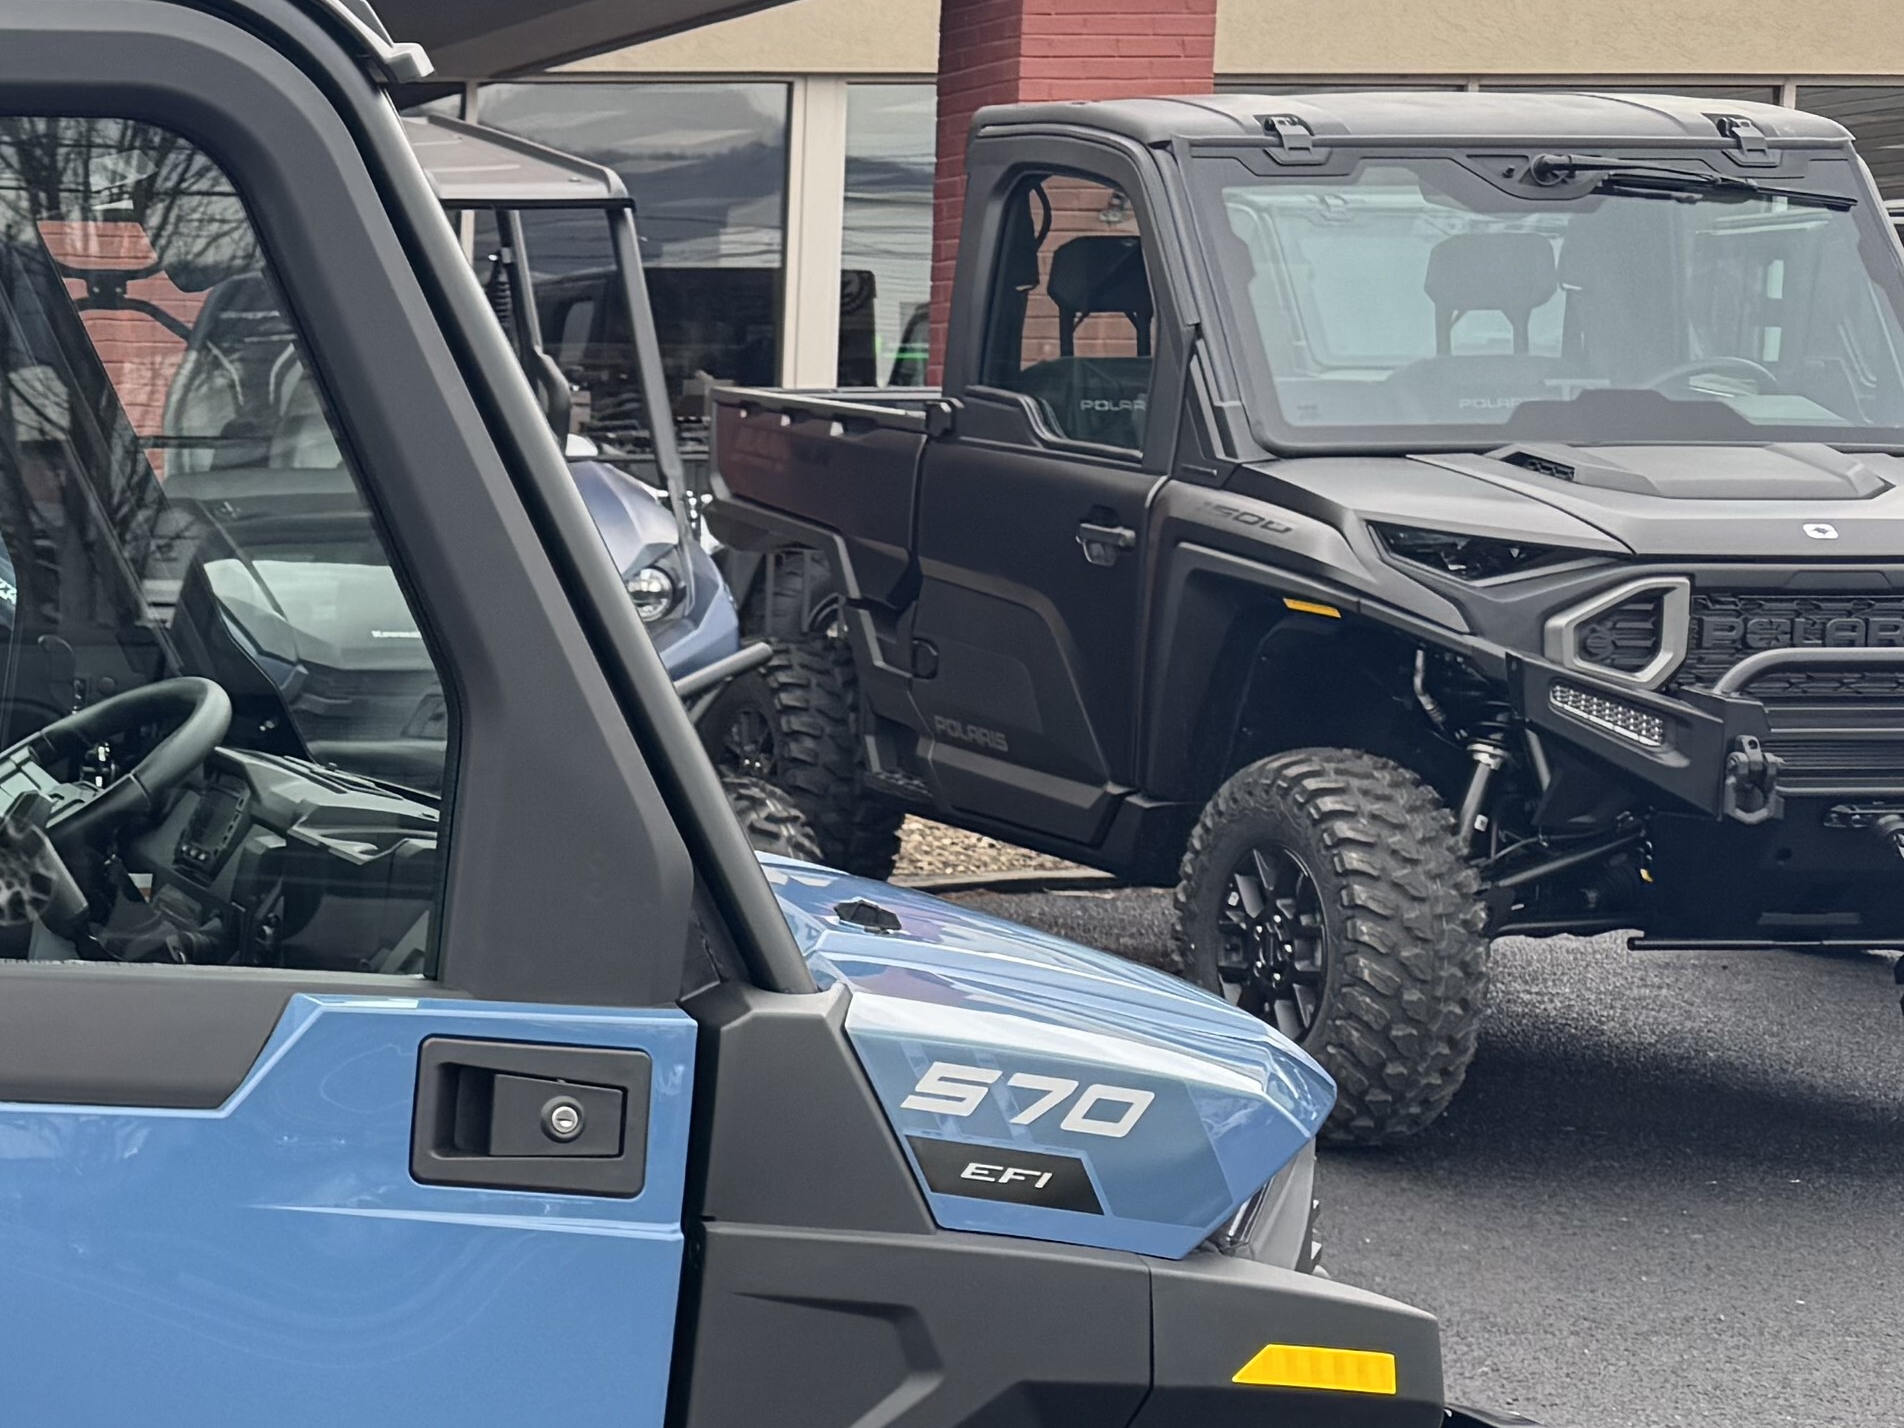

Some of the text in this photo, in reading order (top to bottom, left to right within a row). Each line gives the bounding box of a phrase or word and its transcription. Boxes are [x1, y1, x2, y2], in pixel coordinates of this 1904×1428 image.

[934, 714, 1009, 753] POLARIS
[900, 1061, 1155, 1138] 570
[960, 1162, 1053, 1189] EFI
